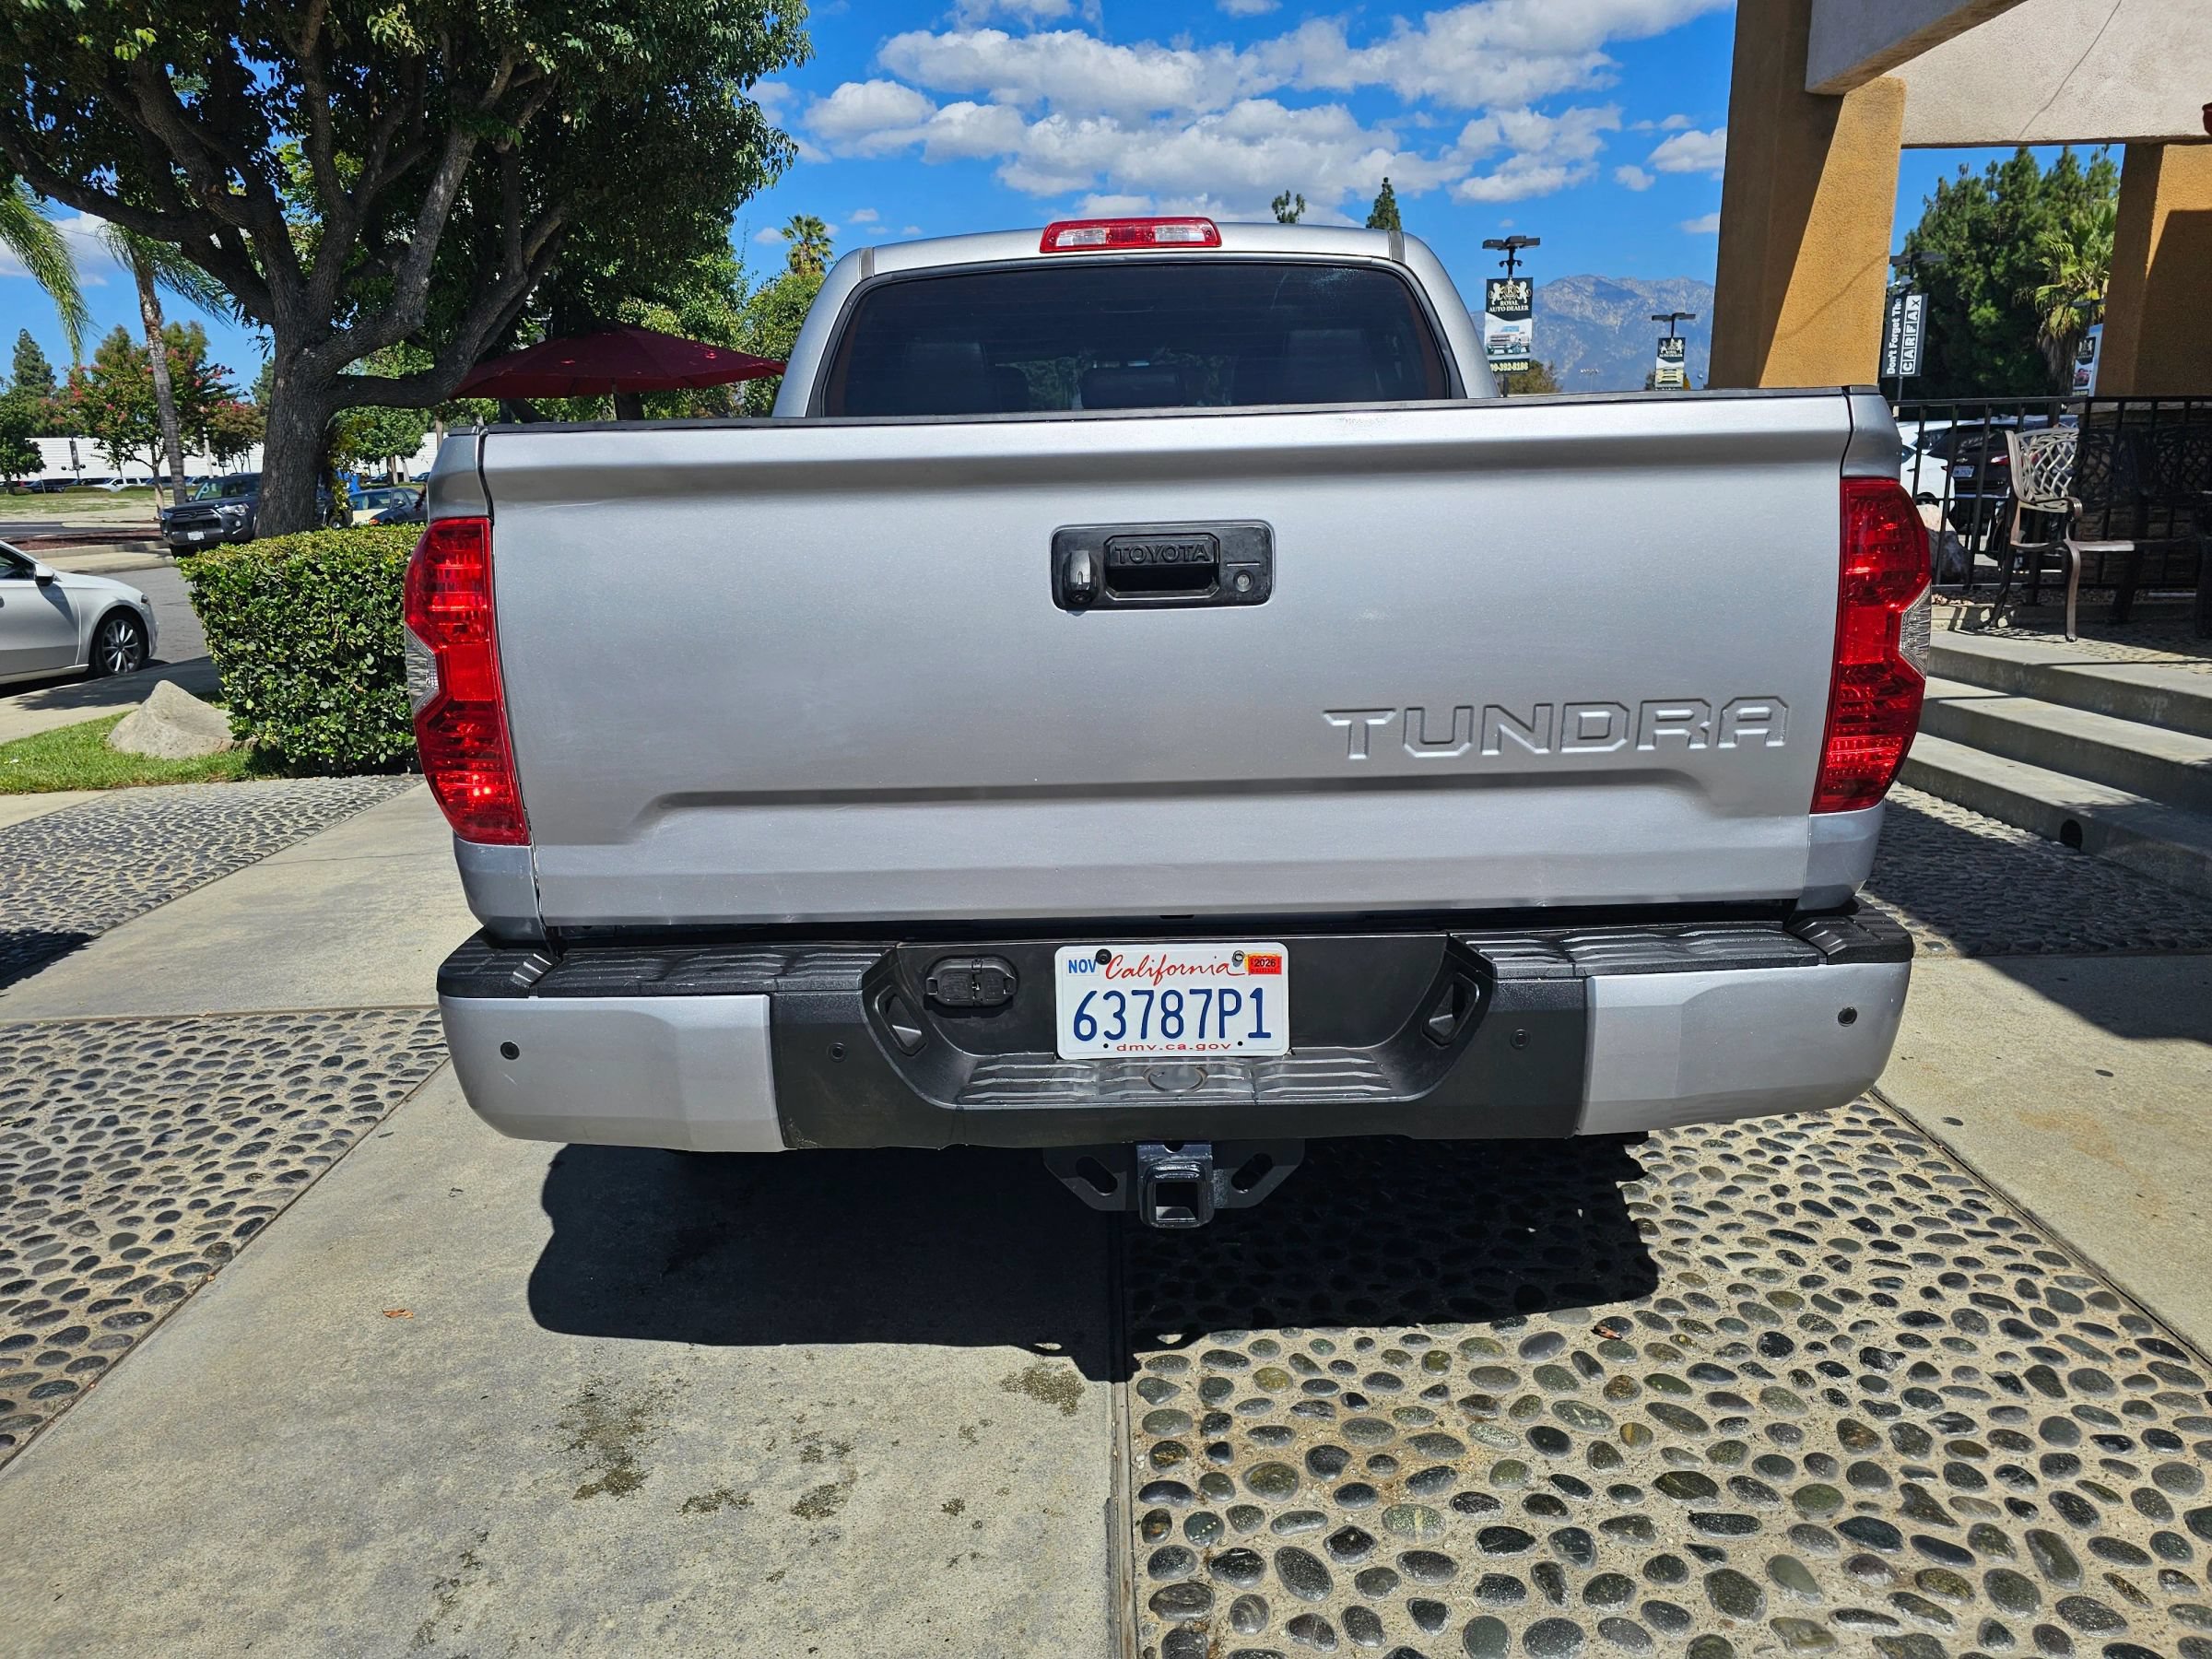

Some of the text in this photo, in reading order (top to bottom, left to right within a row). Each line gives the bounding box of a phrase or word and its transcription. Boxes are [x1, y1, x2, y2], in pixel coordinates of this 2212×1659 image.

[1507, 287, 1513, 295] R
[1887, 298, 1902, 375] Don't Forget The
[1901, 298, 1921, 372] CARFAX
[1115, 544, 1210, 564] TOYOTA
[1323, 696, 1790, 760] TUNDRA
[1068, 959, 1098, 974] NOV
[1105, 954, 1245, 986] California
[1254, 958, 1277, 968] 2026
[1073, 987, 1272, 1041] 63787P1
[1116, 1042, 1231, 1052] dmv.ca.gov
